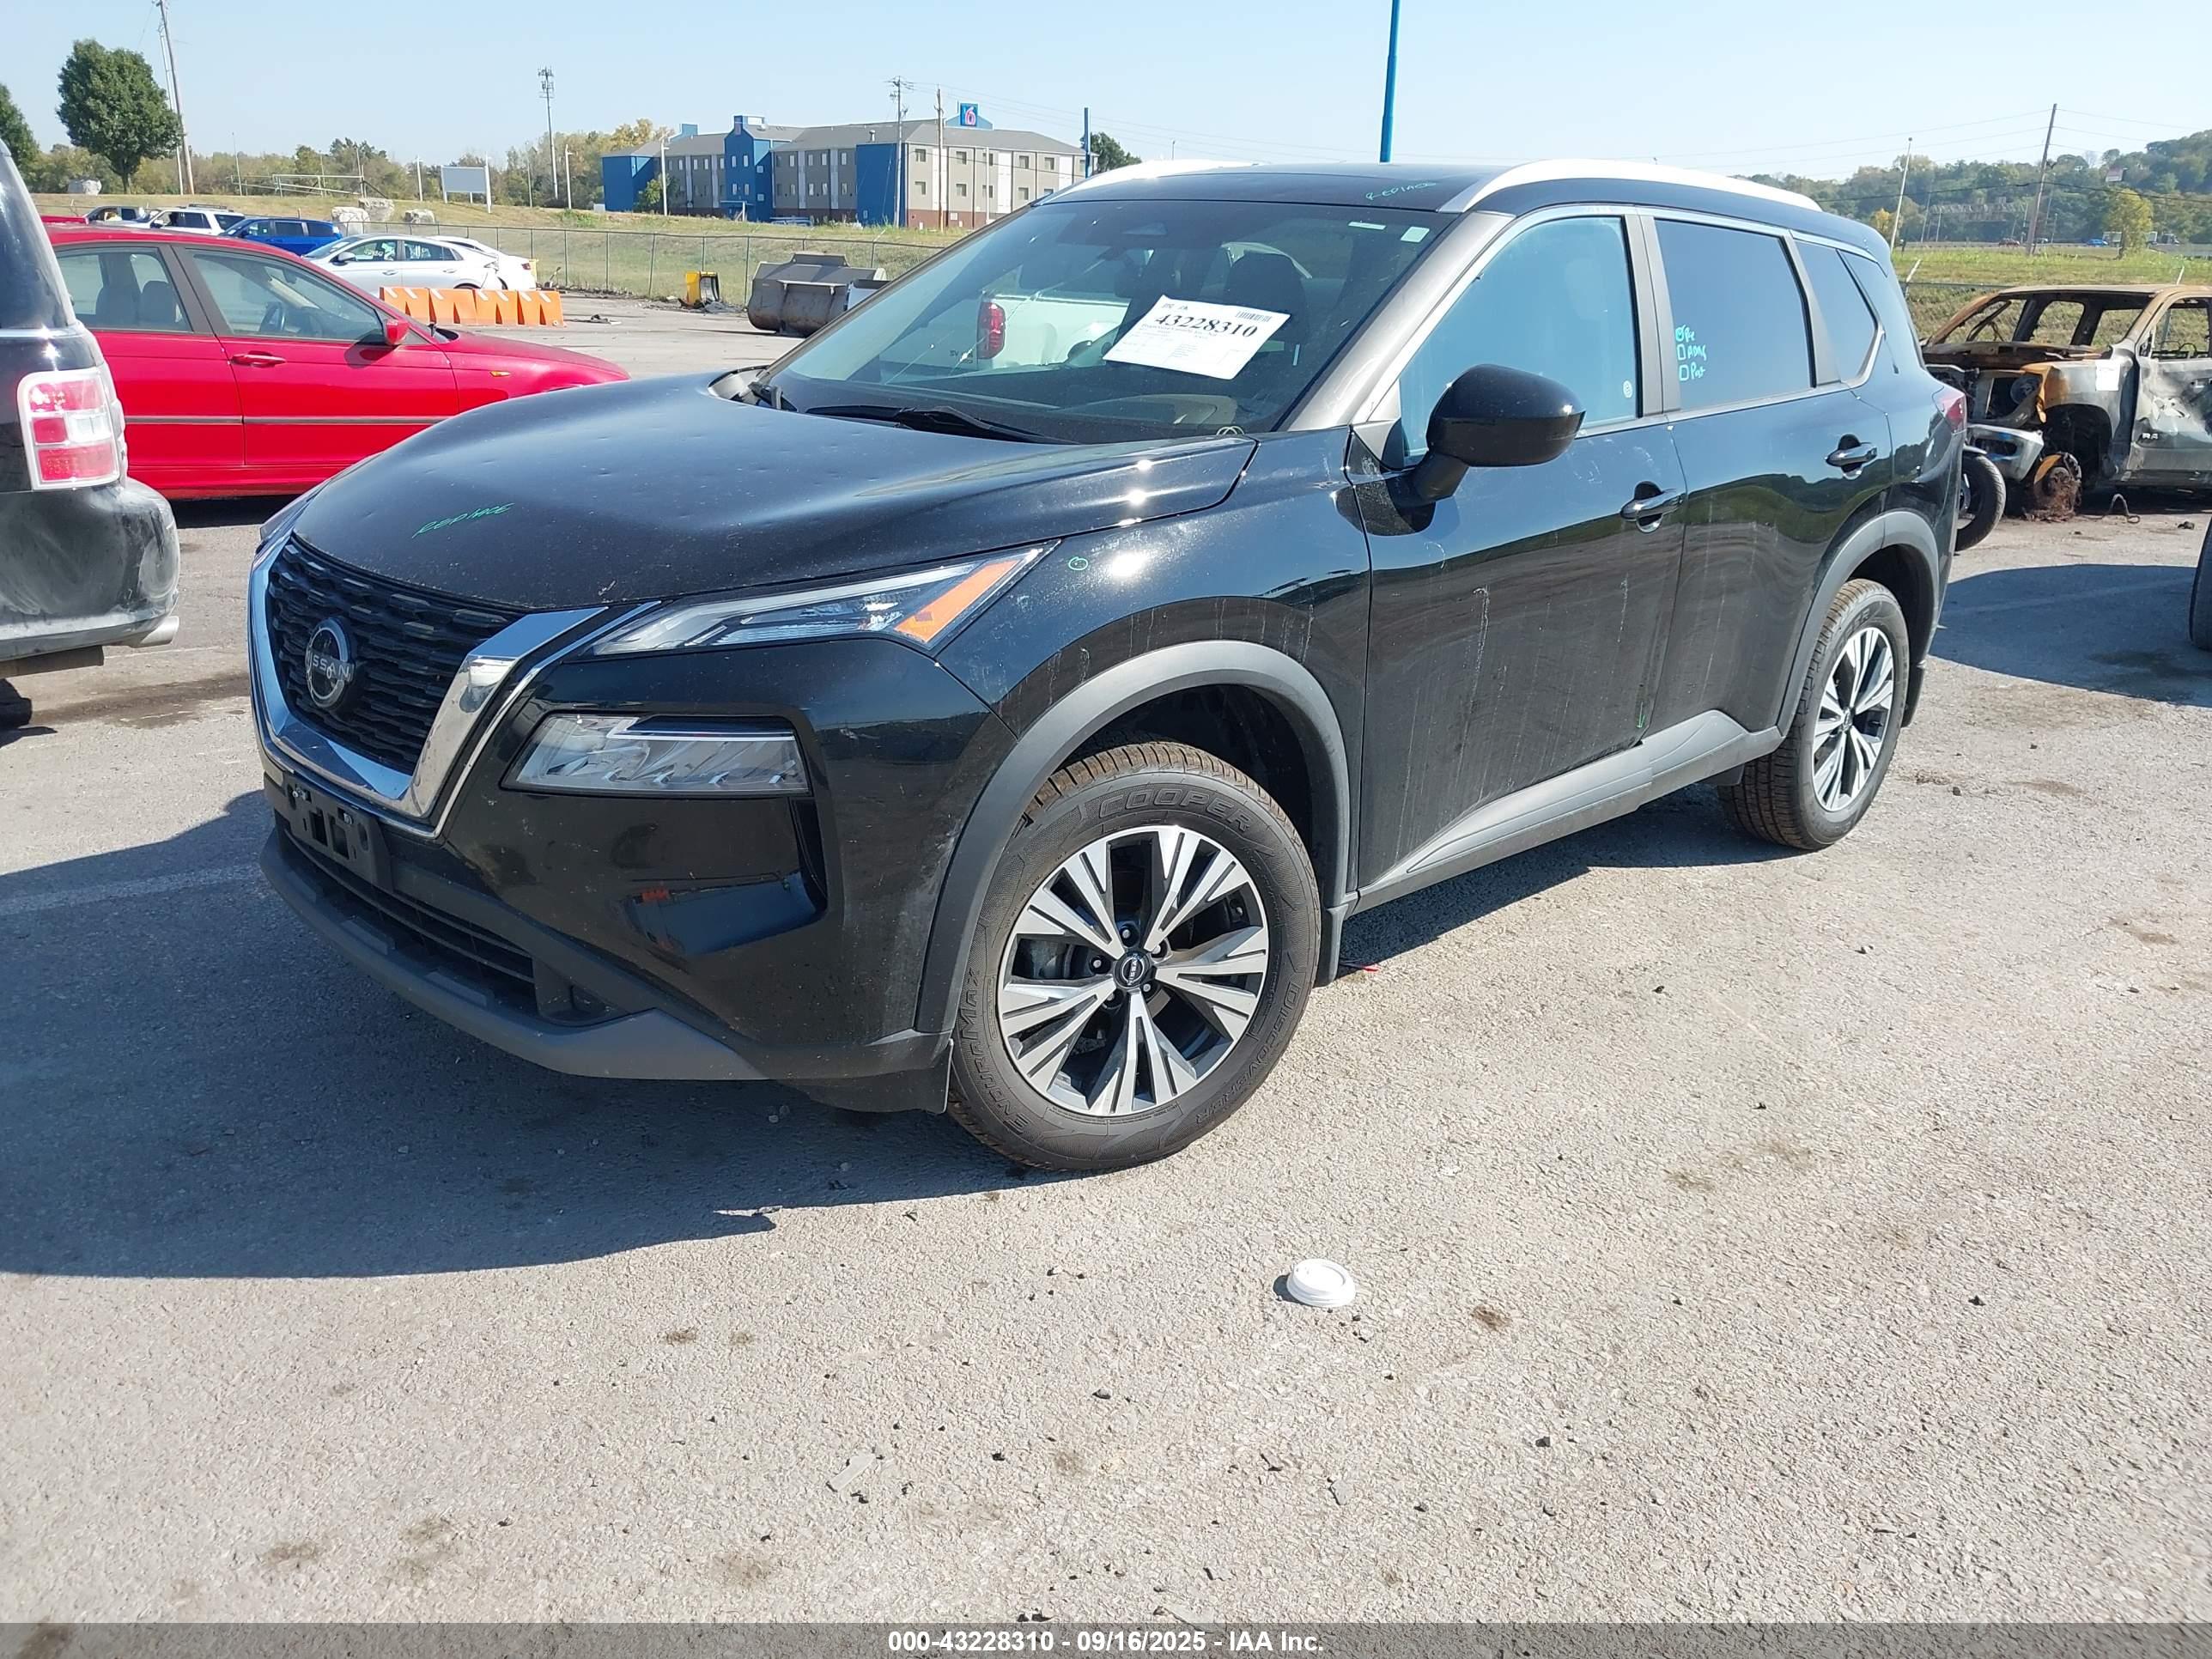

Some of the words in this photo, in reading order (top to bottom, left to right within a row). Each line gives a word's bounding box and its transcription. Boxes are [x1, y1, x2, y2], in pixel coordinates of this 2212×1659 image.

[965, 106, 976, 125] 6
[1155, 313, 1258, 337] 43228310
[1098, 787, 1252, 832] COOPER
